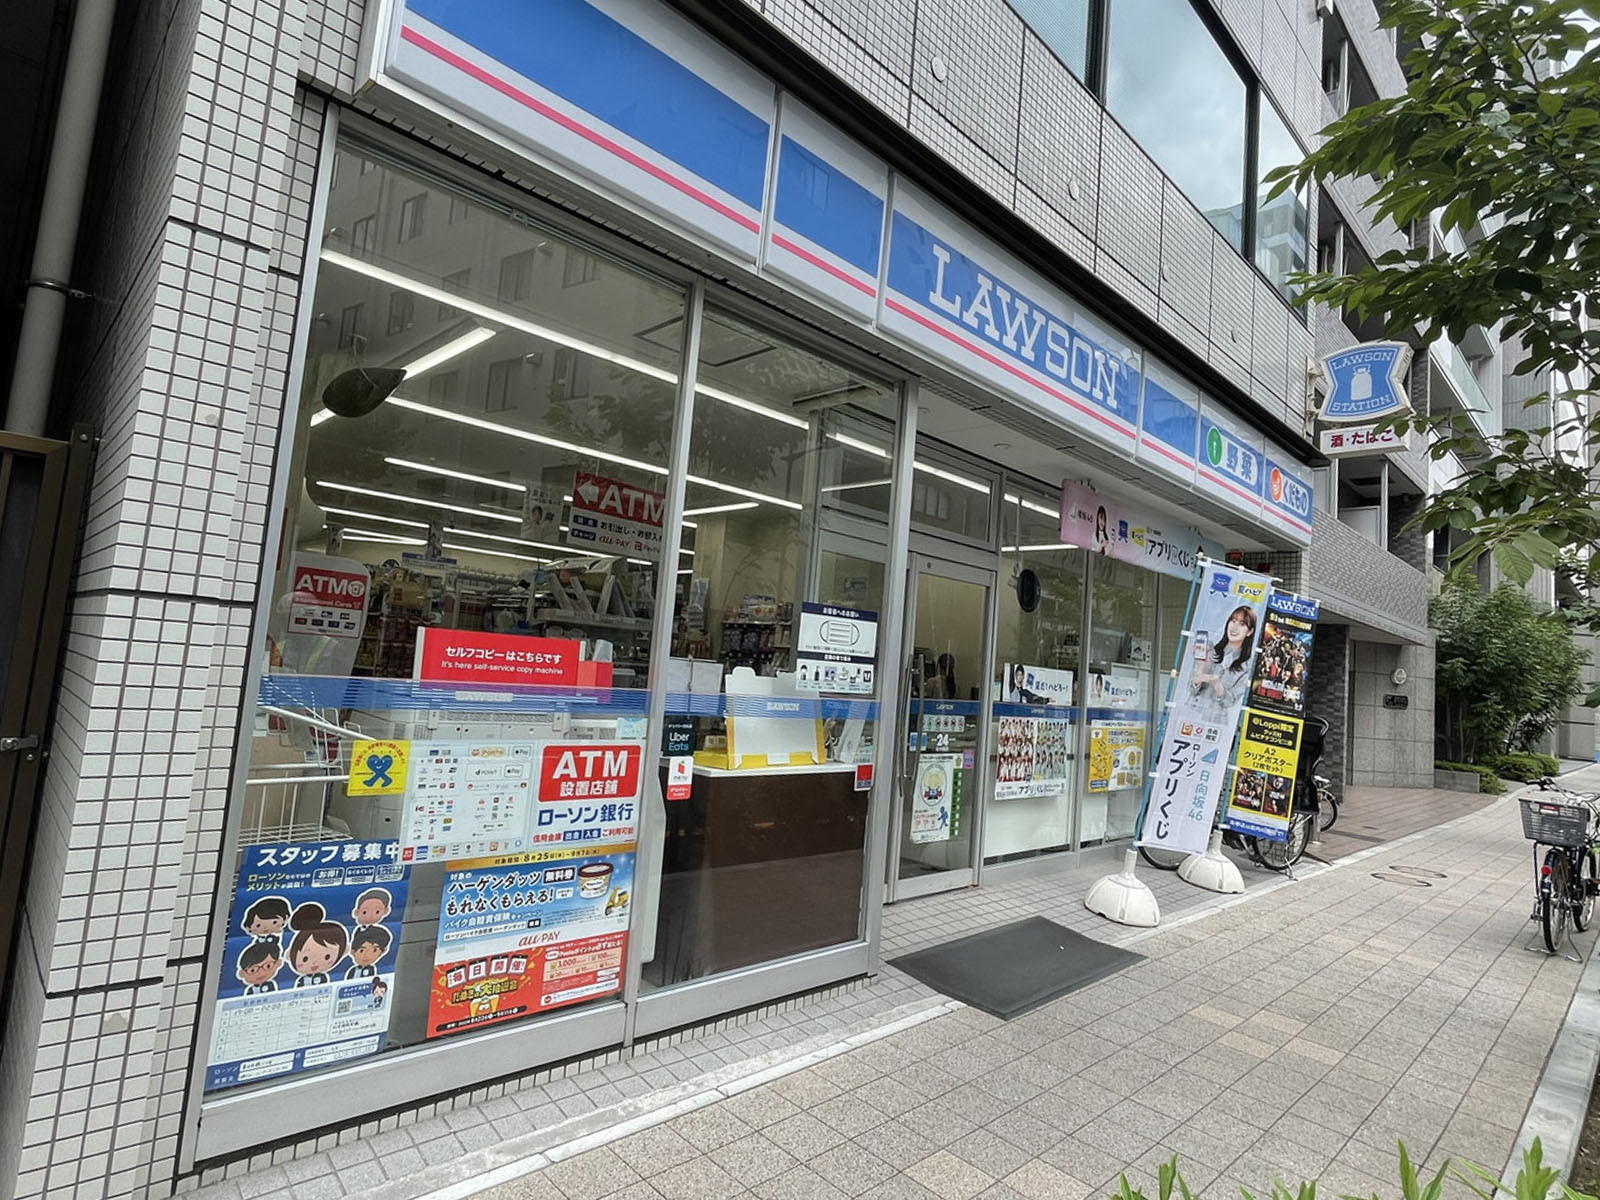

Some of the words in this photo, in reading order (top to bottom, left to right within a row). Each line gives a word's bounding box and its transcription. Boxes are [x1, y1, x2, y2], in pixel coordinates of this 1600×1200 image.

[928, 243, 1118, 410] LAWSON
[1332, 351, 1393, 370] LAWSON
[1331, 395, 1392, 412] STATION
[600, 484, 665, 523] ATM
[296, 574, 348, 596] ATM
[1272, 597, 1316, 617] LAWSON
[445, 646, 562, 665] セルフコピーはこちらです
[454, 661, 472, 669] here
[474, 663, 515, 672] self-service
[516, 667, 534, 675] copy
[535, 667, 563, 675] machine
[669, 732, 690, 741] Uber
[936, 734, 950, 747] 24
[668, 742, 689, 751] Eats
[1264, 747, 1276, 756] A2
[552, 750, 628, 779] ATM
[1244, 751, 1293, 767] クリアポスター
[559, 779, 618, 796] 設置店舗
[1156, 739, 1191, 840] アプリくじ
[1188, 770, 1210, 821] 日向坂46
[537, 803, 634, 827] ローソン銀行
[256, 842, 400, 868] スタッフ募集中
[448, 871, 542, 894] ハーゲンダッツ
[545, 869, 576, 883] 無料券
[446, 888, 554, 917] もれなくもらえる!
[518, 935, 539, 947] au
[541, 932, 561, 942] PAY
